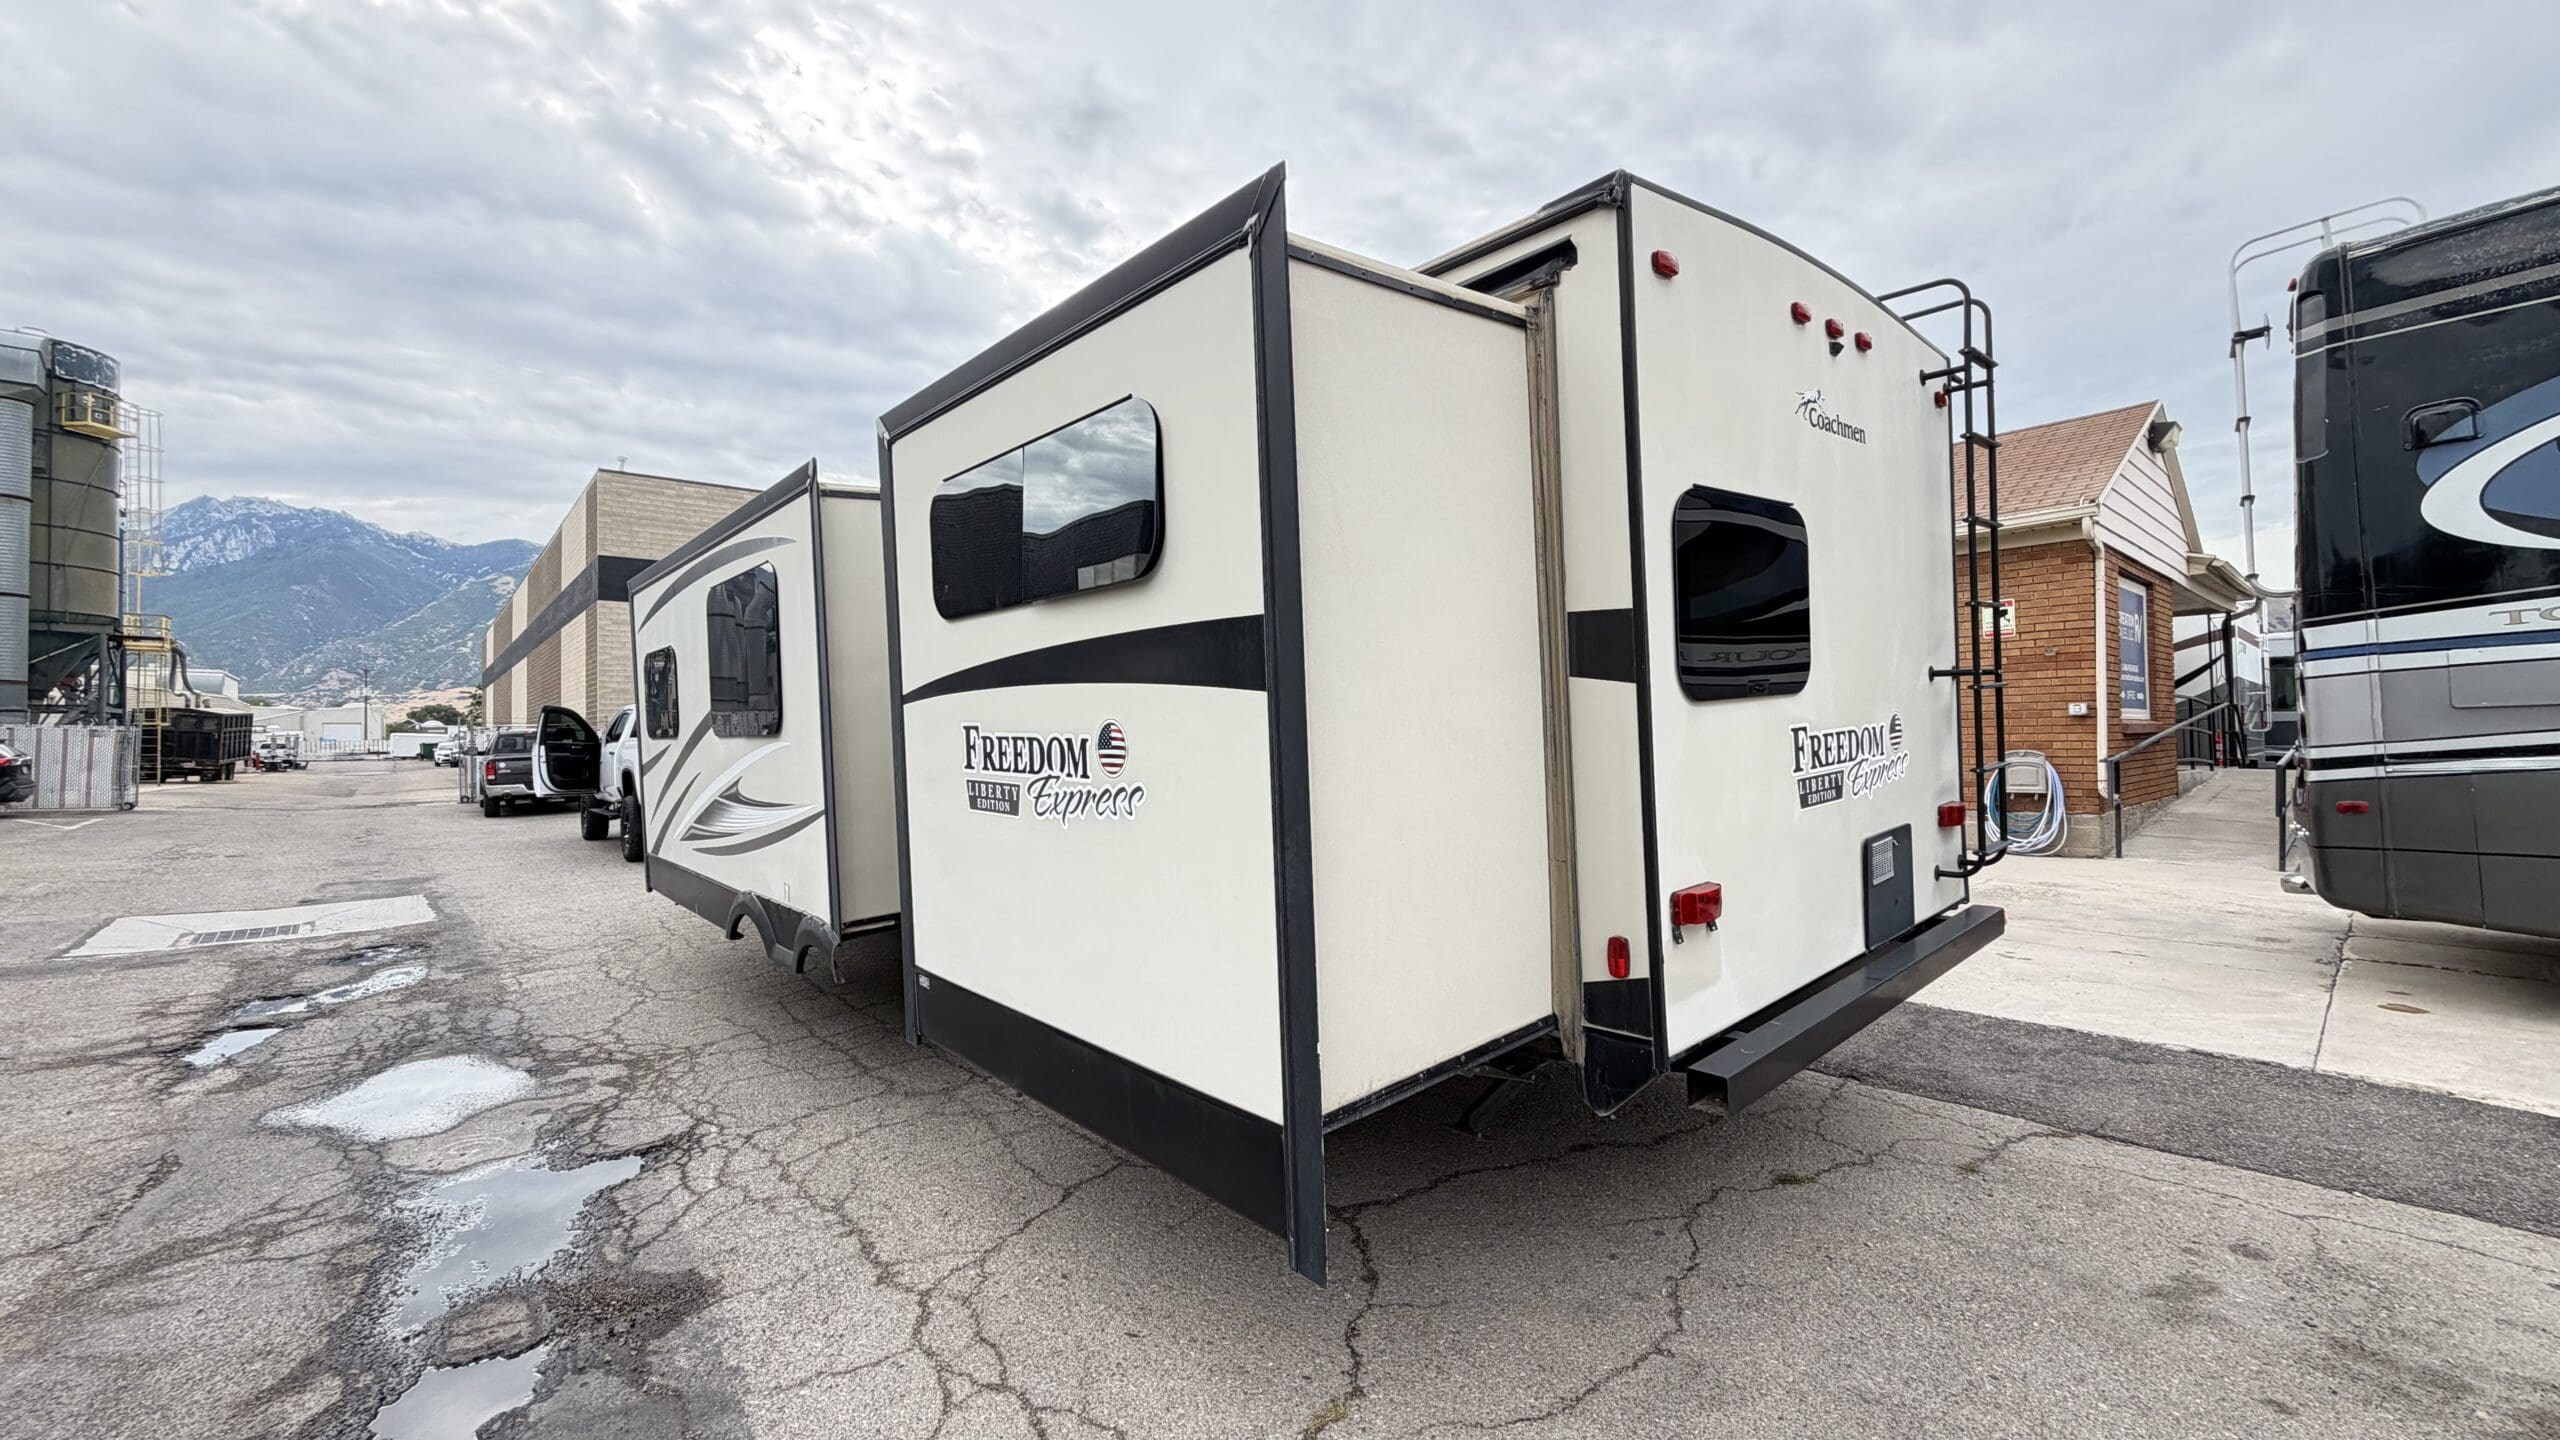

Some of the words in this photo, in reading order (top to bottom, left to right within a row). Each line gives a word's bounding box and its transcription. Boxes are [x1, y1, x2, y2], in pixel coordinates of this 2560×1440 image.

[1808, 407, 1866, 444] Coachmen
[963, 725, 1090, 779] FREEDOM
[1790, 725, 1885, 773] FREEDOM
[967, 782, 1019, 801] LIBERTY
[1799, 772, 1843, 795] LIBERTY
[1848, 753, 1908, 798] Express
[977, 799, 1011, 813] EDITION
[1026, 774, 1145, 827] Express
[1807, 788, 1837, 805] EDITION
